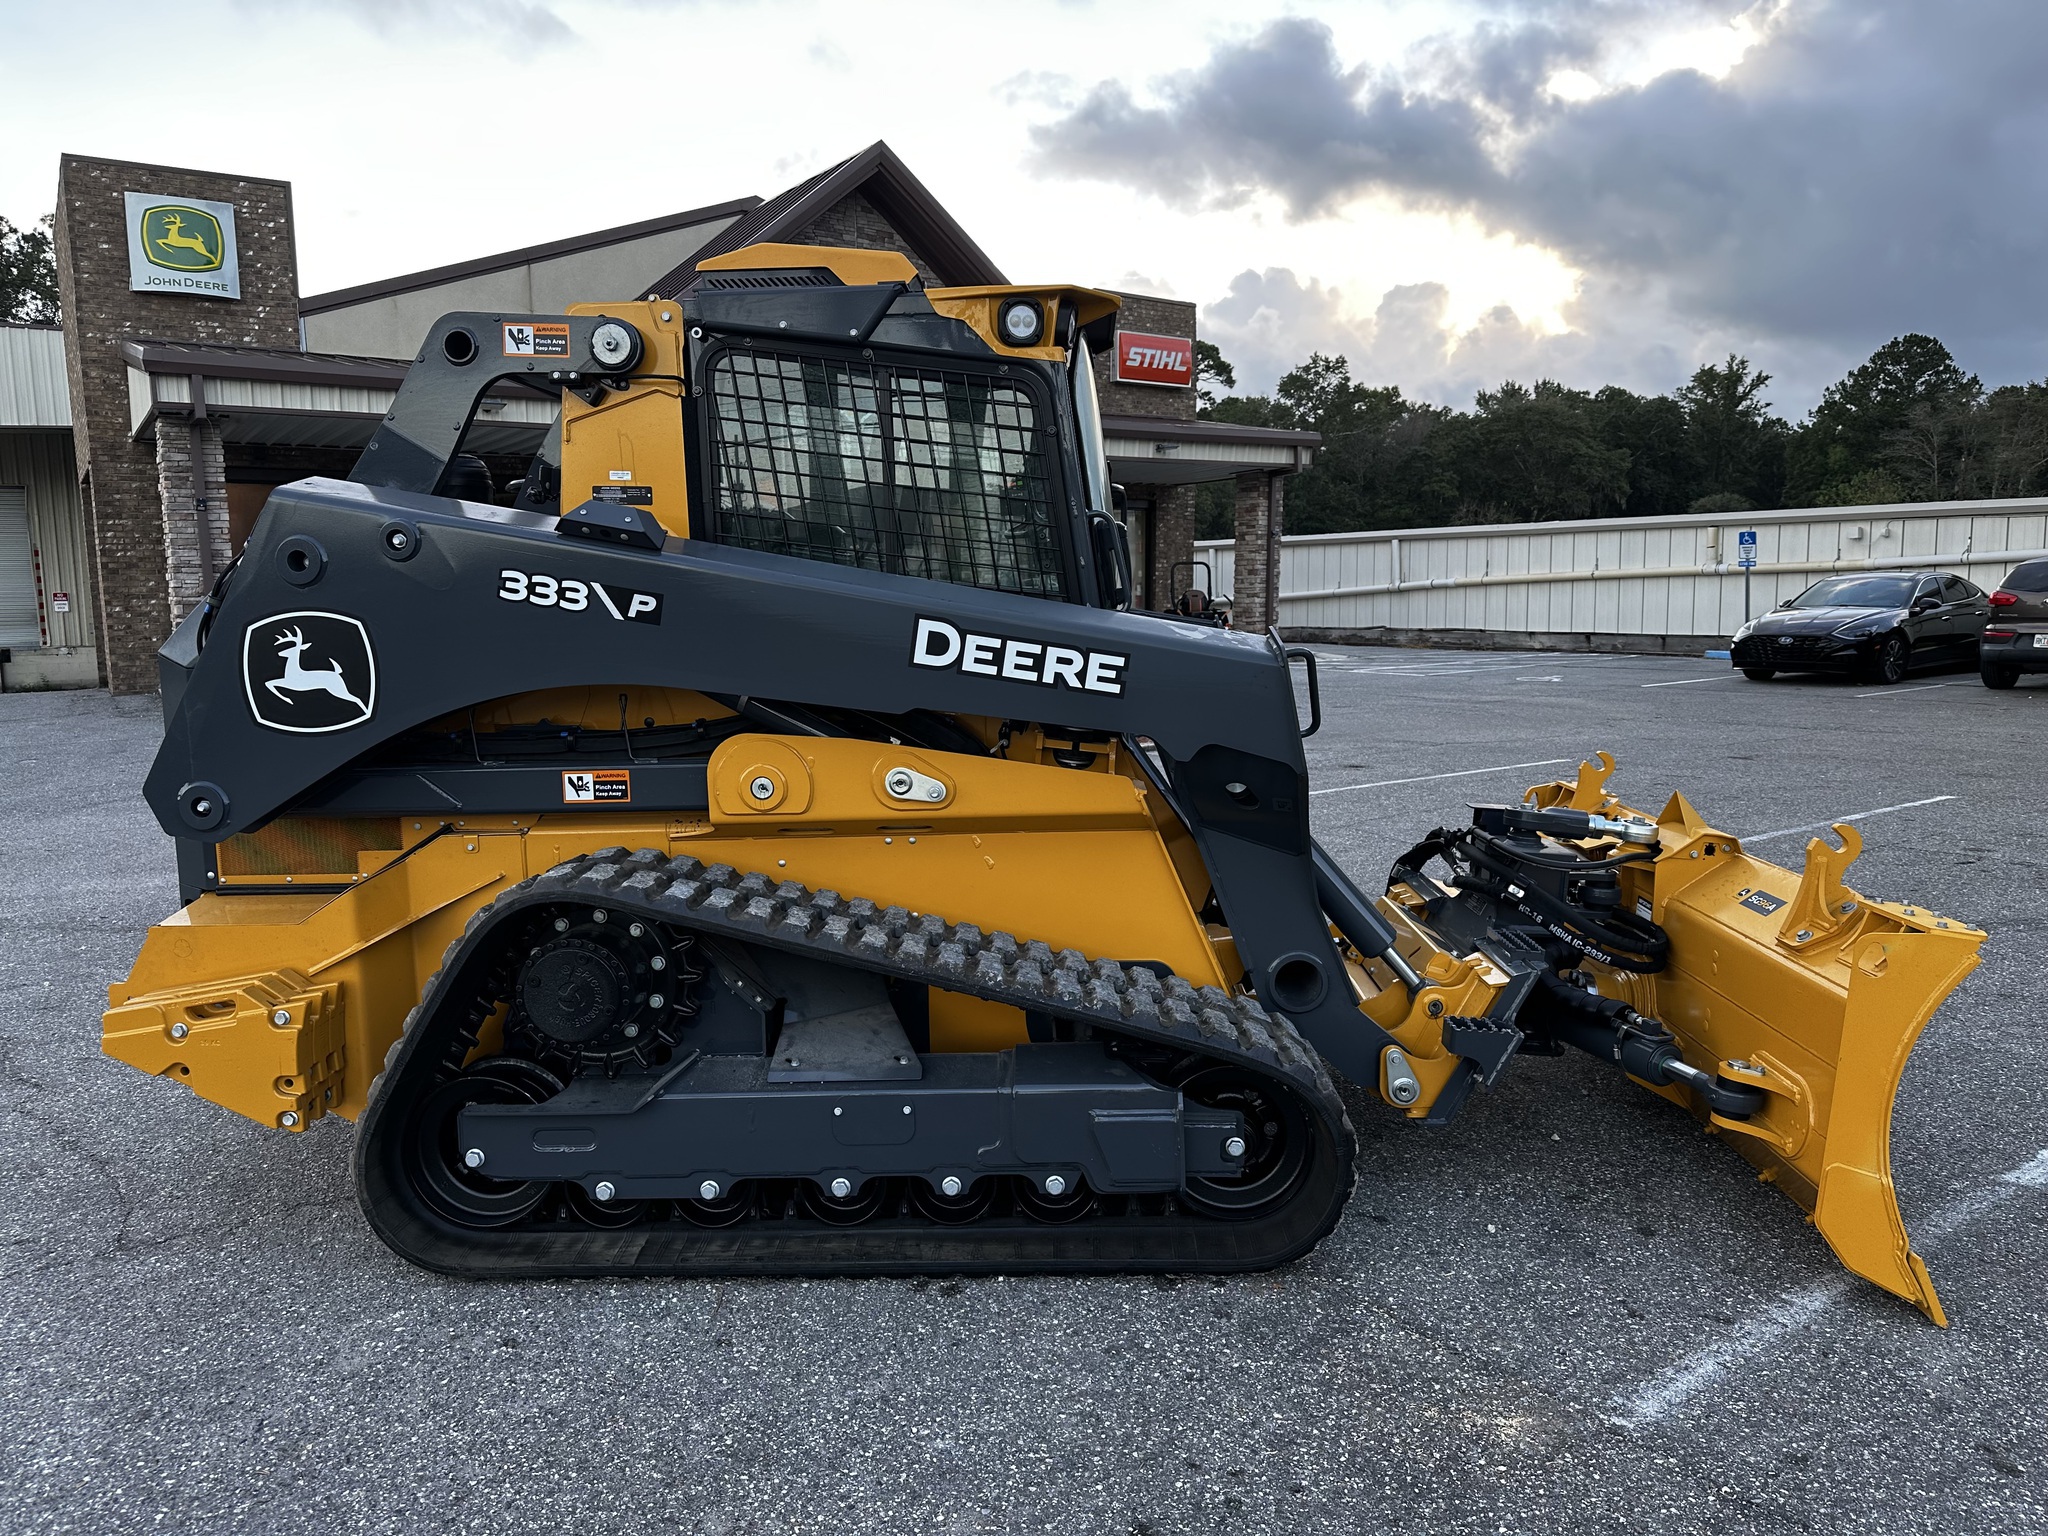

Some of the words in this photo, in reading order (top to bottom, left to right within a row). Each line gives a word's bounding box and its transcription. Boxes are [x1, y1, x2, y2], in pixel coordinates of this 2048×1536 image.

[144, 275, 182, 287] JOHN
[184, 278, 229, 292] DEERE
[1125, 346, 1188, 372] STIHL
[912, 617, 1126, 695] DEERE
[1548, 923, 1573, 944] MSHA
